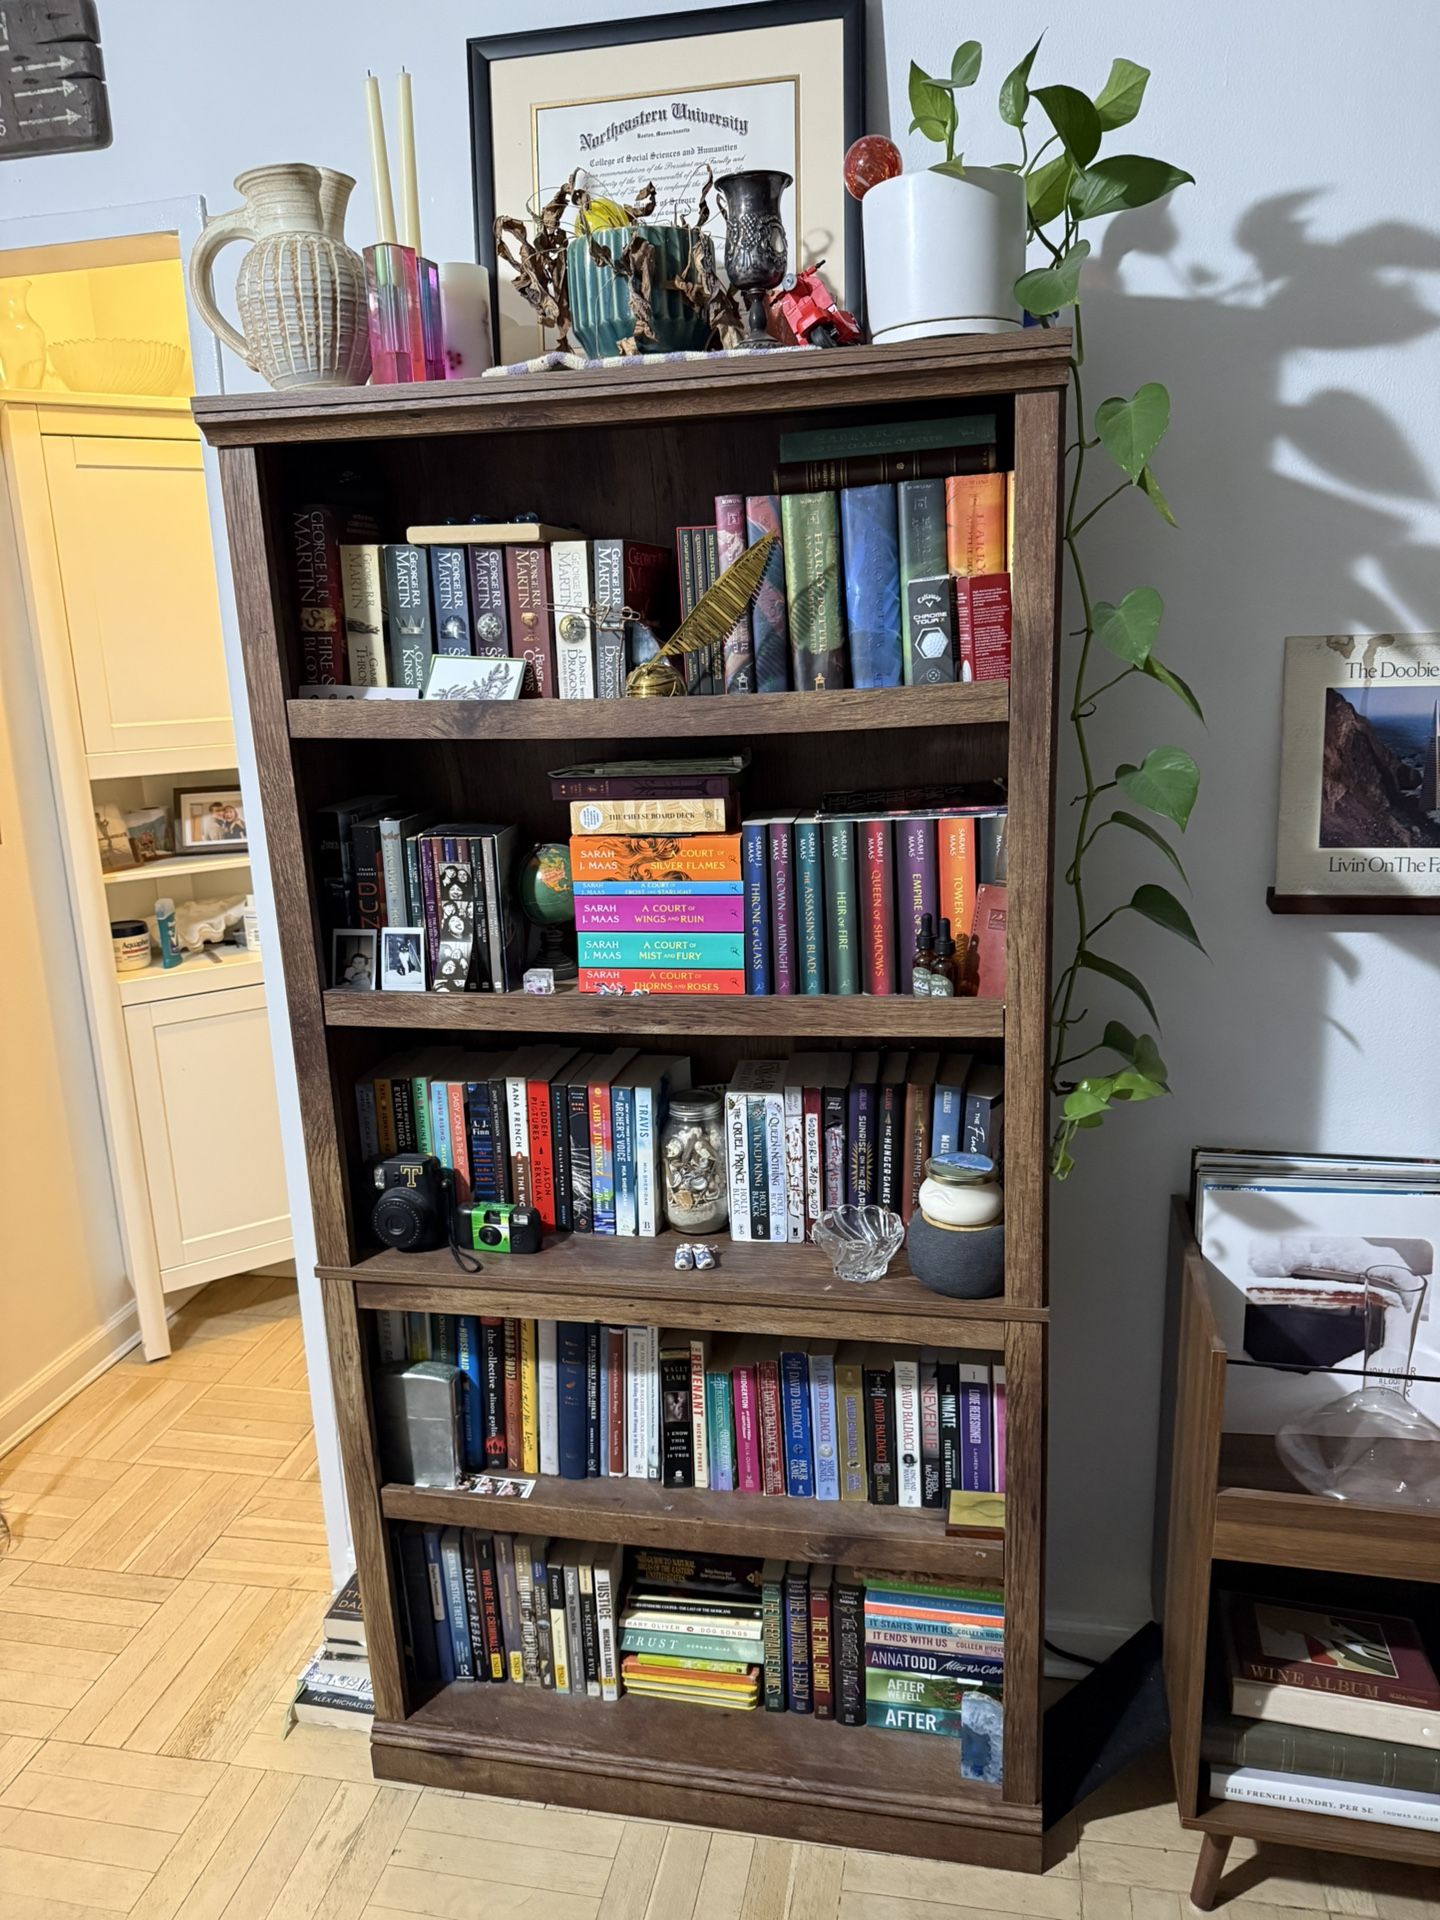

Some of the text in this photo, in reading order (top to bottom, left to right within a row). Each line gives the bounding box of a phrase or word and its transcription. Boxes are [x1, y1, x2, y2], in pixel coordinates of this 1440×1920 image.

[580, 102, 749, 152] Northeastern University
[590, 144, 738, 168] College of Social Sciences and Humanities
[293, 512, 316, 602] MARTIN
[311, 511, 328, 570] GEORGE
[396, 550, 411, 608] MARTIN
[410, 551, 418, 588] GEORGE
[438, 552, 454, 610] MARTIN
[452, 552, 461, 589] GEORGE
[475, 551, 490, 609] MARTIN
[490, 552, 499, 589] GEORGE
[515, 550, 530, 608] MARTIN
[530, 550, 539, 588] GEORGE
[598, 547, 612, 607] MARTIN
[612, 548, 621, 586] GEORGE
[814, 532, 826, 652] HARRY POTTER
[913, 612, 947, 620] CHROME
[402, 648, 414, 686] KINGS
[568, 649, 578, 700] DRAGONS
[605, 646, 616, 700] DRAGONS
[1345, 661, 1440, 679] The Doobie
[651, 862, 683, 870] SILVER
[687, 862, 725, 870] FLAMES
[680, 849, 713, 858] COURT
[1328, 856, 1426, 873] Livin' On The
[751, 882, 761, 924] THRONE
[776, 870, 786, 911] CROWN
[836, 891, 847, 916] HEIR
[871, 870, 882, 907] QUEEN
[591, 915, 620, 923] MAAS
[681, 915, 704, 923] RUIN
[586, 940, 619, 949] SARAH
[676, 952, 702, 960] FURY
[752, 939, 762, 970] GLASS
[778, 923, 788, 974] MIDNIGHT
[838, 930, 848, 950] FIRE
[873, 924, 884, 977] SHADOWS
[806, 944, 816, 975] BLADE
[633, 982, 672, 990] THORNS
[687, 982, 719, 990] ROSES
[514, 1112, 522, 1148] FRENCH
[530, 1097, 540, 1141] PICTURES
[540, 1101, 549, 1136] HIDDEN
[639, 1104, 649, 1138] TRAVIS
[858, 1115, 867, 1153] SUNRISE
[617, 1142, 626, 1162] VOICE
[732, 1122, 745, 1185] CRUEL PRINCE
[400, 1164, 423, 1188] T
[534, 1161, 542, 1201] REKULAK
[543, 1167, 551, 1196] JASON
[882, 1138, 892, 1204] HUNGER GAMES
[759, 1191, 768, 1217] HOLLY
[488, 1329, 496, 1344] the
[488, 1346, 498, 1389] collective
[690, 1354, 704, 1417] REVENANT
[789, 1371, 803, 1439] DAVID BALDACCI
[902, 1384, 914, 1451] DAVID BALDACCI
[922, 1384, 937, 1450] NEVER LIE
[942, 1395, 956, 1429] INMATE
[487, 1416, 497, 1437] gaylin
[800, 1460, 808, 1481] HOUR
[464, 1567, 477, 1604] RULES
[596, 1581, 612, 1620] JUSTICE
[469, 1614, 483, 1655] REBELS
[624, 1635, 678, 1650] TRUST
[870, 1618, 953, 1635] IT STARTS WITH US
[873, 1631, 947, 1648] IT ENDS WITH US
[812, 1616, 830, 1693] THE FINAL GAMBIT
[888, 1679, 925, 1693] AFTER
[888, 1690, 922, 1702] WE FELL
[1251, 1664, 1379, 1698] WINE ALBUM
[885, 1708, 937, 1731] AFTER
[1224, 1786, 1244, 1796] THE
[1246, 1789, 1286, 1801] FRENCH
[1339, 1803, 1360, 1812] PER
[1362, 1806, 1374, 1814] SE
[1382, 1810, 1412, 1819] THOMAS
[1414, 1813, 1439, 1822] KELLER
